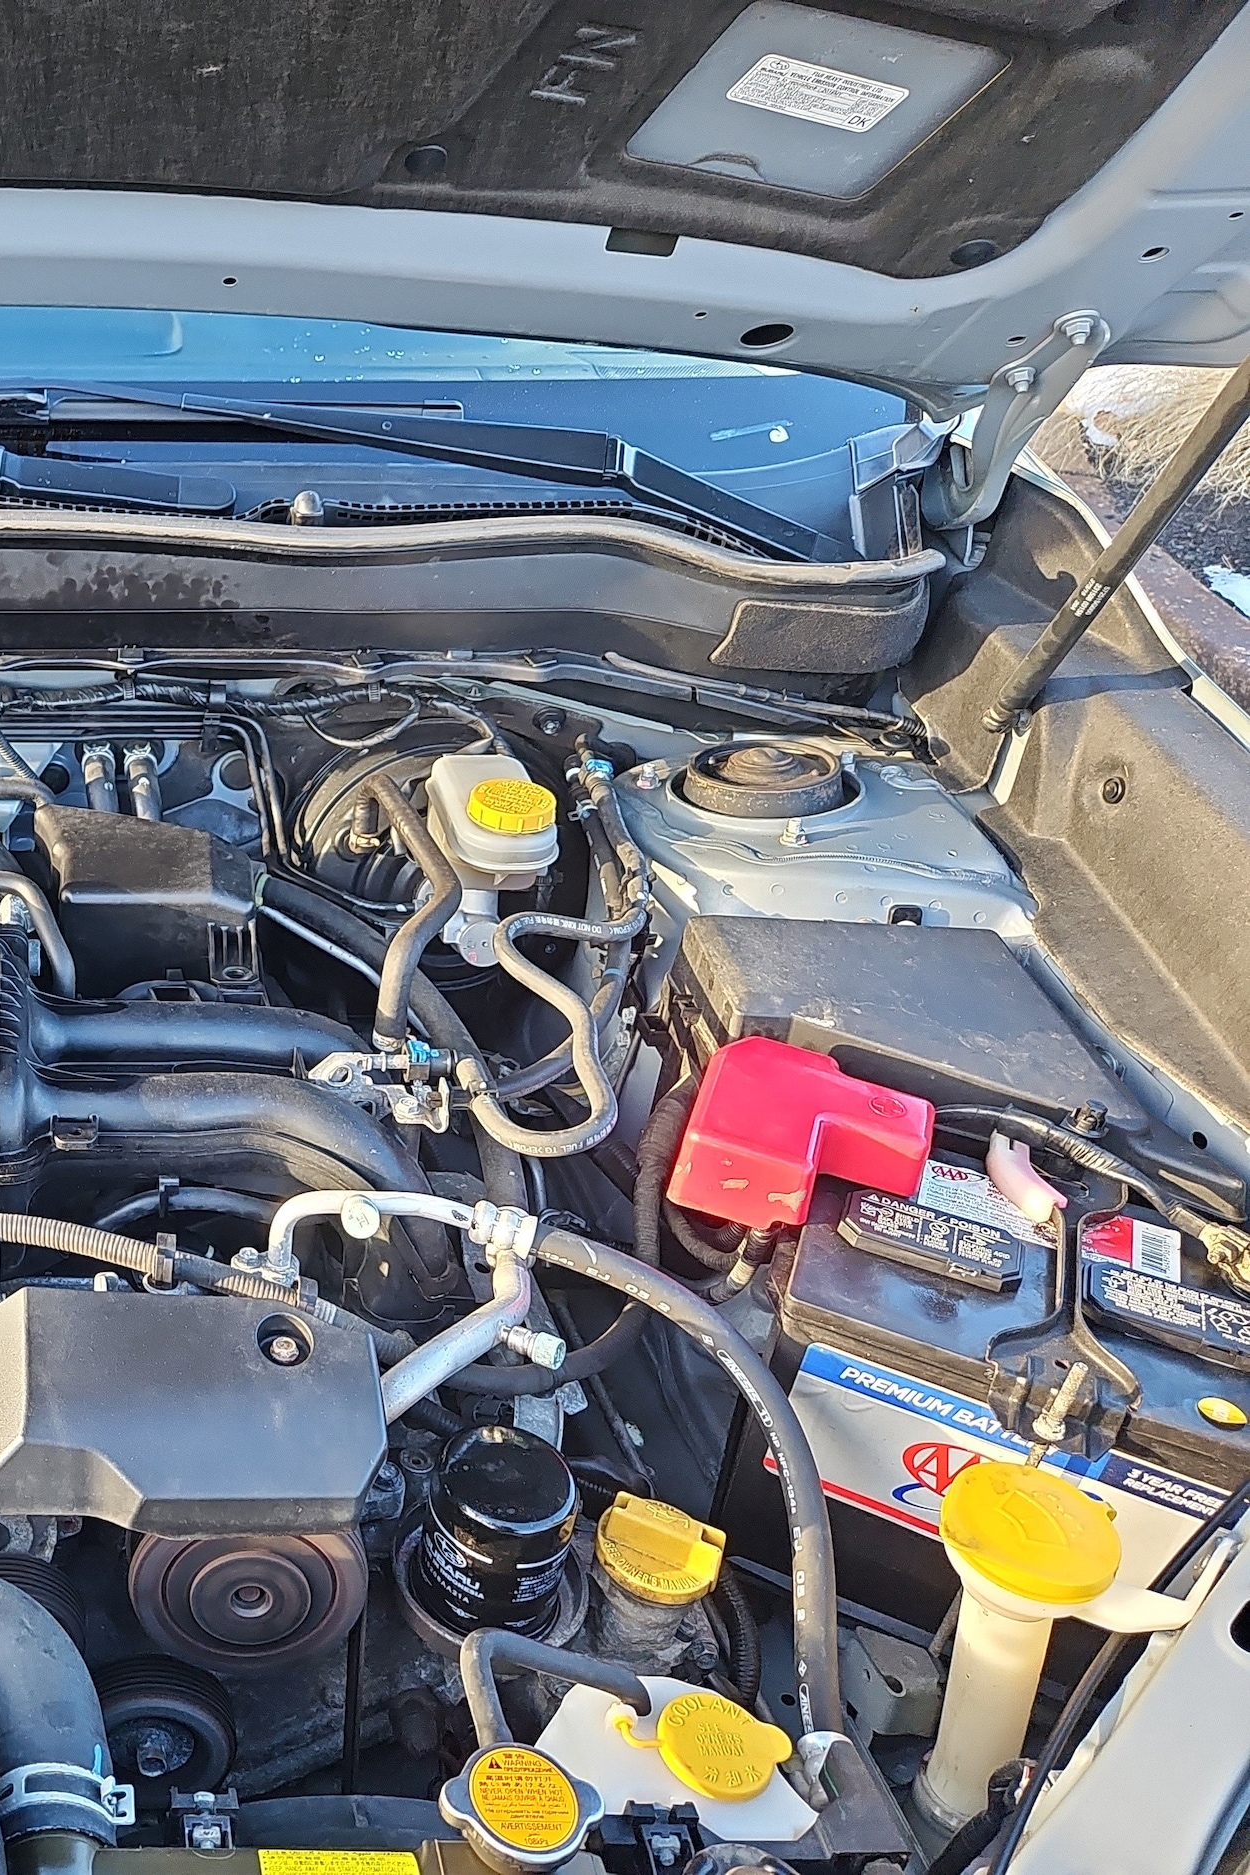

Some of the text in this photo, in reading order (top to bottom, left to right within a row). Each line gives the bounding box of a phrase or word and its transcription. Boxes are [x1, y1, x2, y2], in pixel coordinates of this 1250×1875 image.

[760, 67, 786, 76] SUBARU
[790, 72, 895, 103] VEHICLE EMISSION CONTROL INFORMATION
[824, 74, 842, 83] HEAVY
[842, 79, 872, 91] INDUSTRIES
[848, 116, 872, 128] DK
[577, 923, 591, 932] NOT
[592, 926, 602, 934] DO
[560, 1142, 583, 1153] FUEL
[932, 1166, 968, 1181] AAA
[882, 1196, 936, 1220] DANGER
[950, 1217, 1001, 1239] POISON
[958, 1240, 1010, 1260] SULFURIC ACID
[839, 1366, 955, 1417] PREMIUM
[585, 1266, 611, 1282] EJ
[657, 1301, 671, 1313] 2
[769, 1432, 781, 1449] HP
[777, 1452, 797, 1514] HFC-134a
[793, 1527, 803, 1552] EJ
[1123, 1478, 1216, 1516] REPLACEMENT
[1127, 1468, 1225, 1509] 3 YEAR FREE
[604, 1541, 700, 1590] SEE OWNER'S MANUAL
[440, 1567, 485, 1600] INDONESIA
[666, 1695, 756, 1727] COOLANT
[698, 1723, 722, 1733] SEE
[695, 1733, 742, 1744] OWNERS
[699, 1745, 744, 1756] MANUAL
[500, 1823, 563, 1831] AVERTISSEMENT
